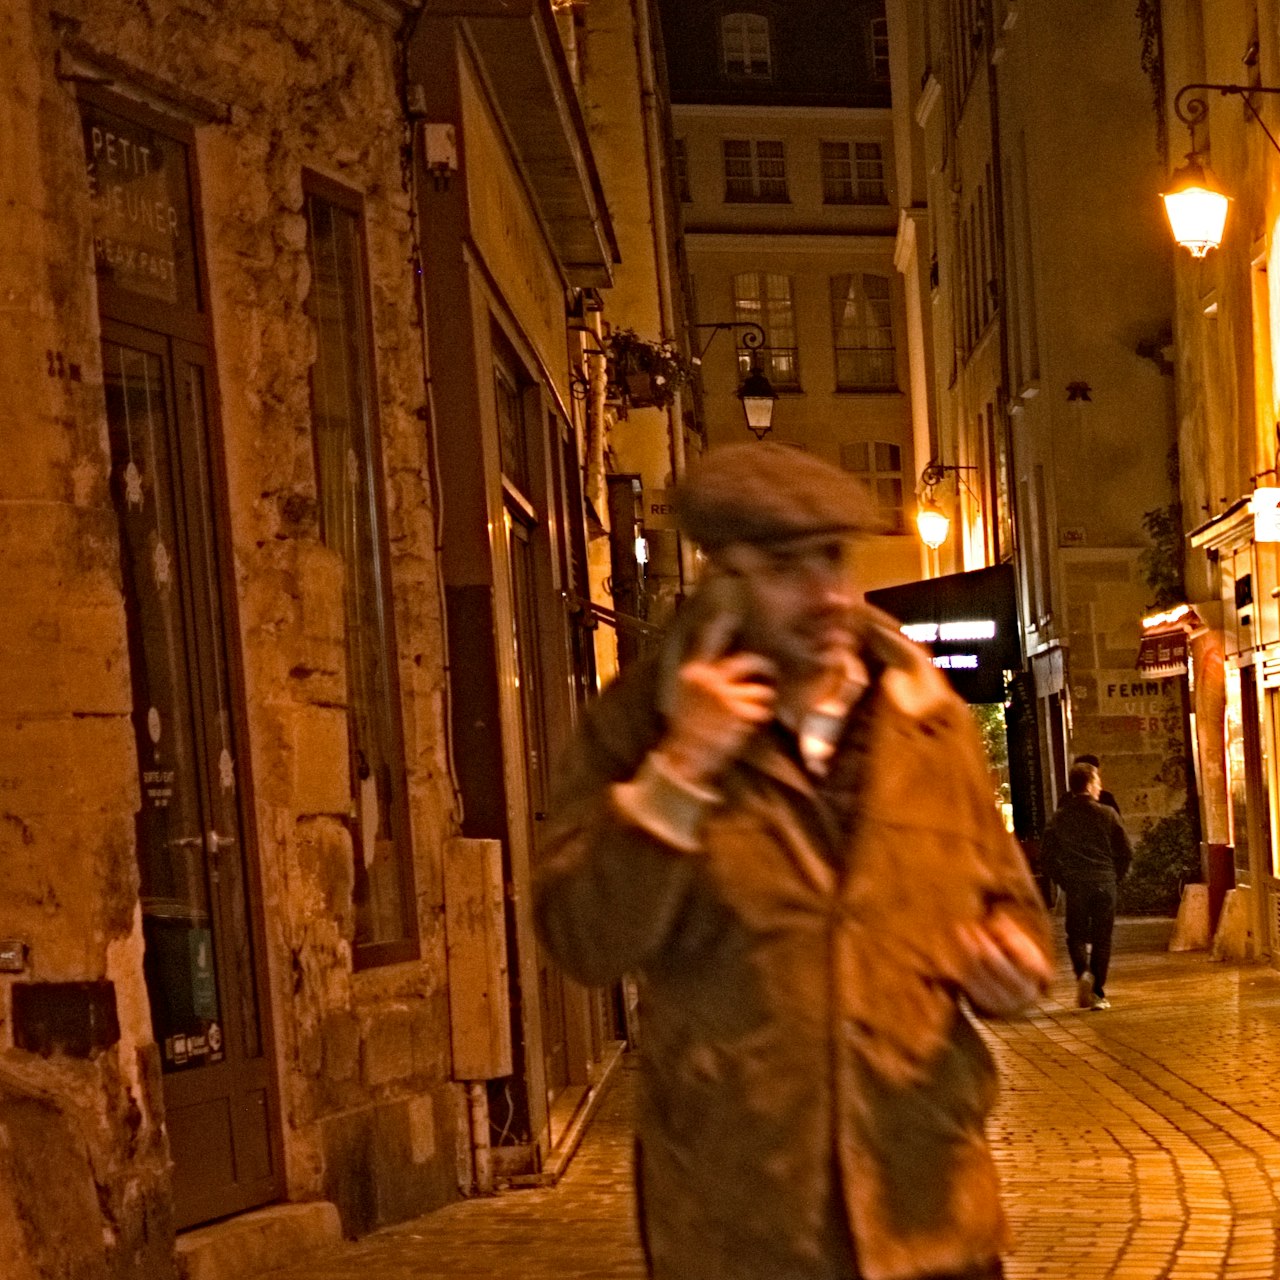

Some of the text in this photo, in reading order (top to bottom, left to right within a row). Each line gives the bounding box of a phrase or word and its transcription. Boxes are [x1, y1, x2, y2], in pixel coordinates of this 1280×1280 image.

[91, 126, 150, 177] PETIT
[86, 162, 179, 238] ÉJEUNER
[95, 235, 175, 282] REAKFAST
[1124, 701, 1159, 715] VIE
